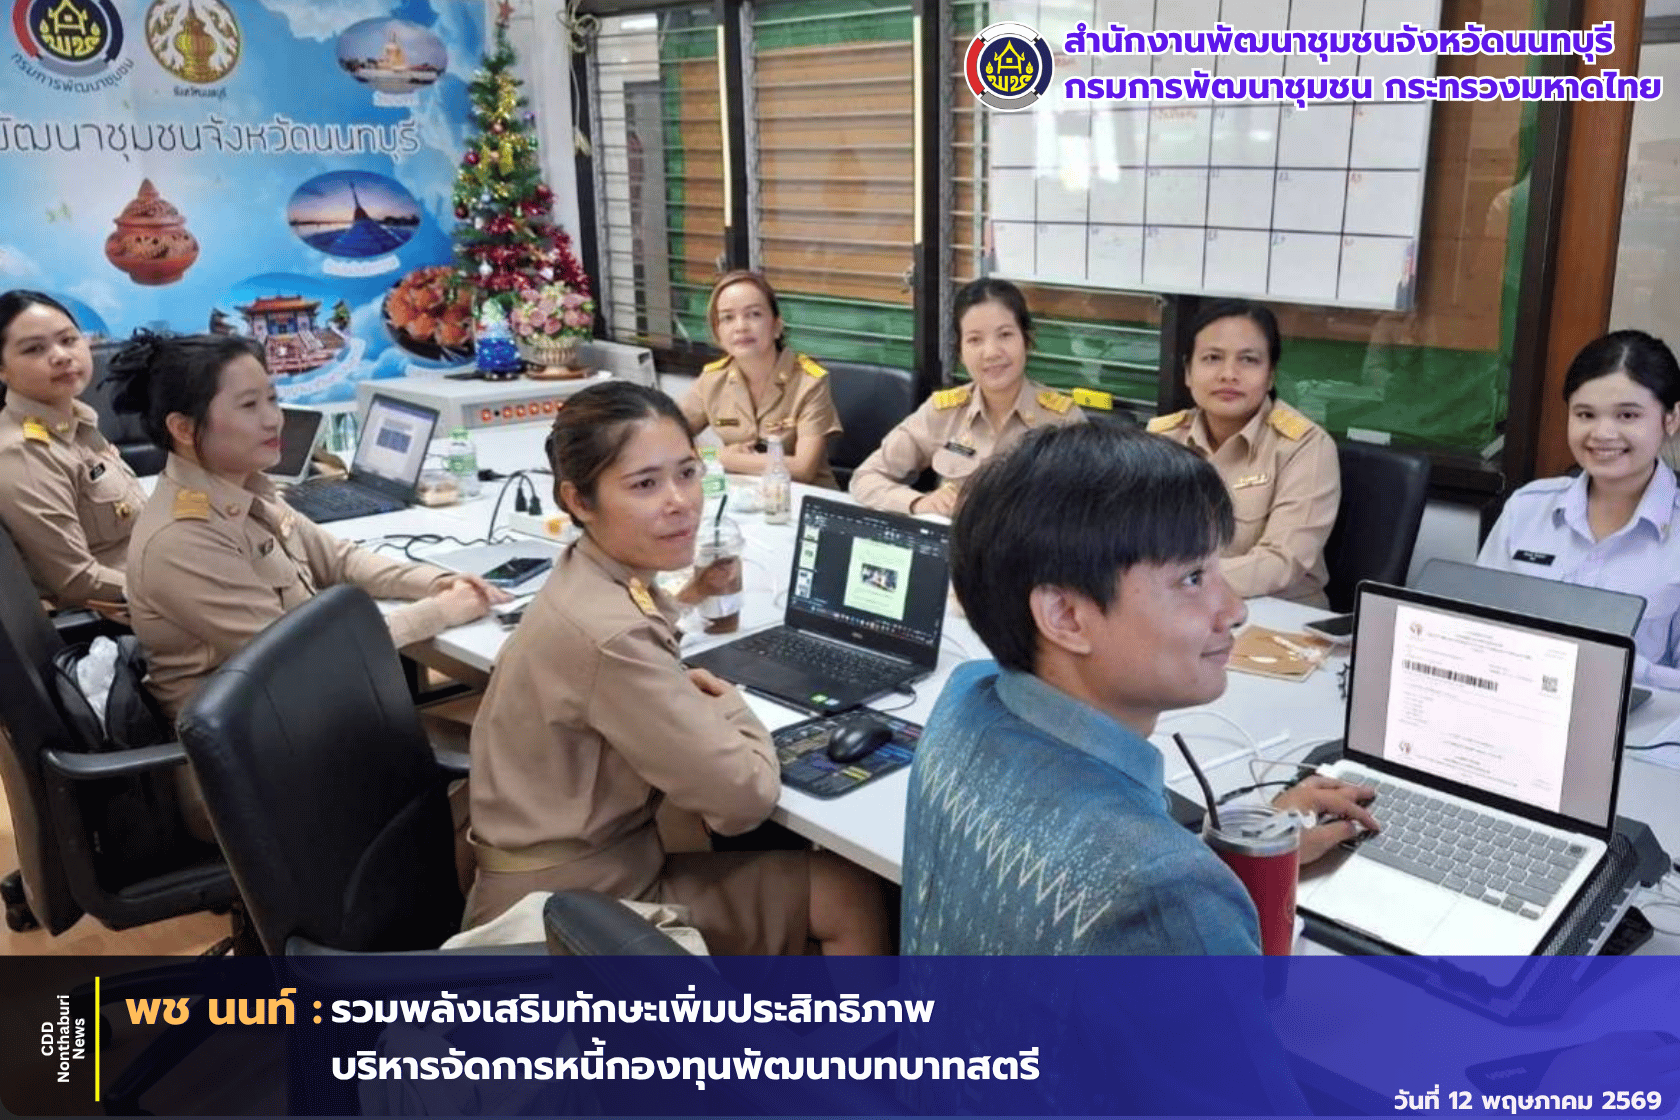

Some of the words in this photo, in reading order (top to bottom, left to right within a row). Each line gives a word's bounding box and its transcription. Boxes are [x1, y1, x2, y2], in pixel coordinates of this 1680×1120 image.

[11, 52, 134, 92] กรมการพัฒนาชุมชน
